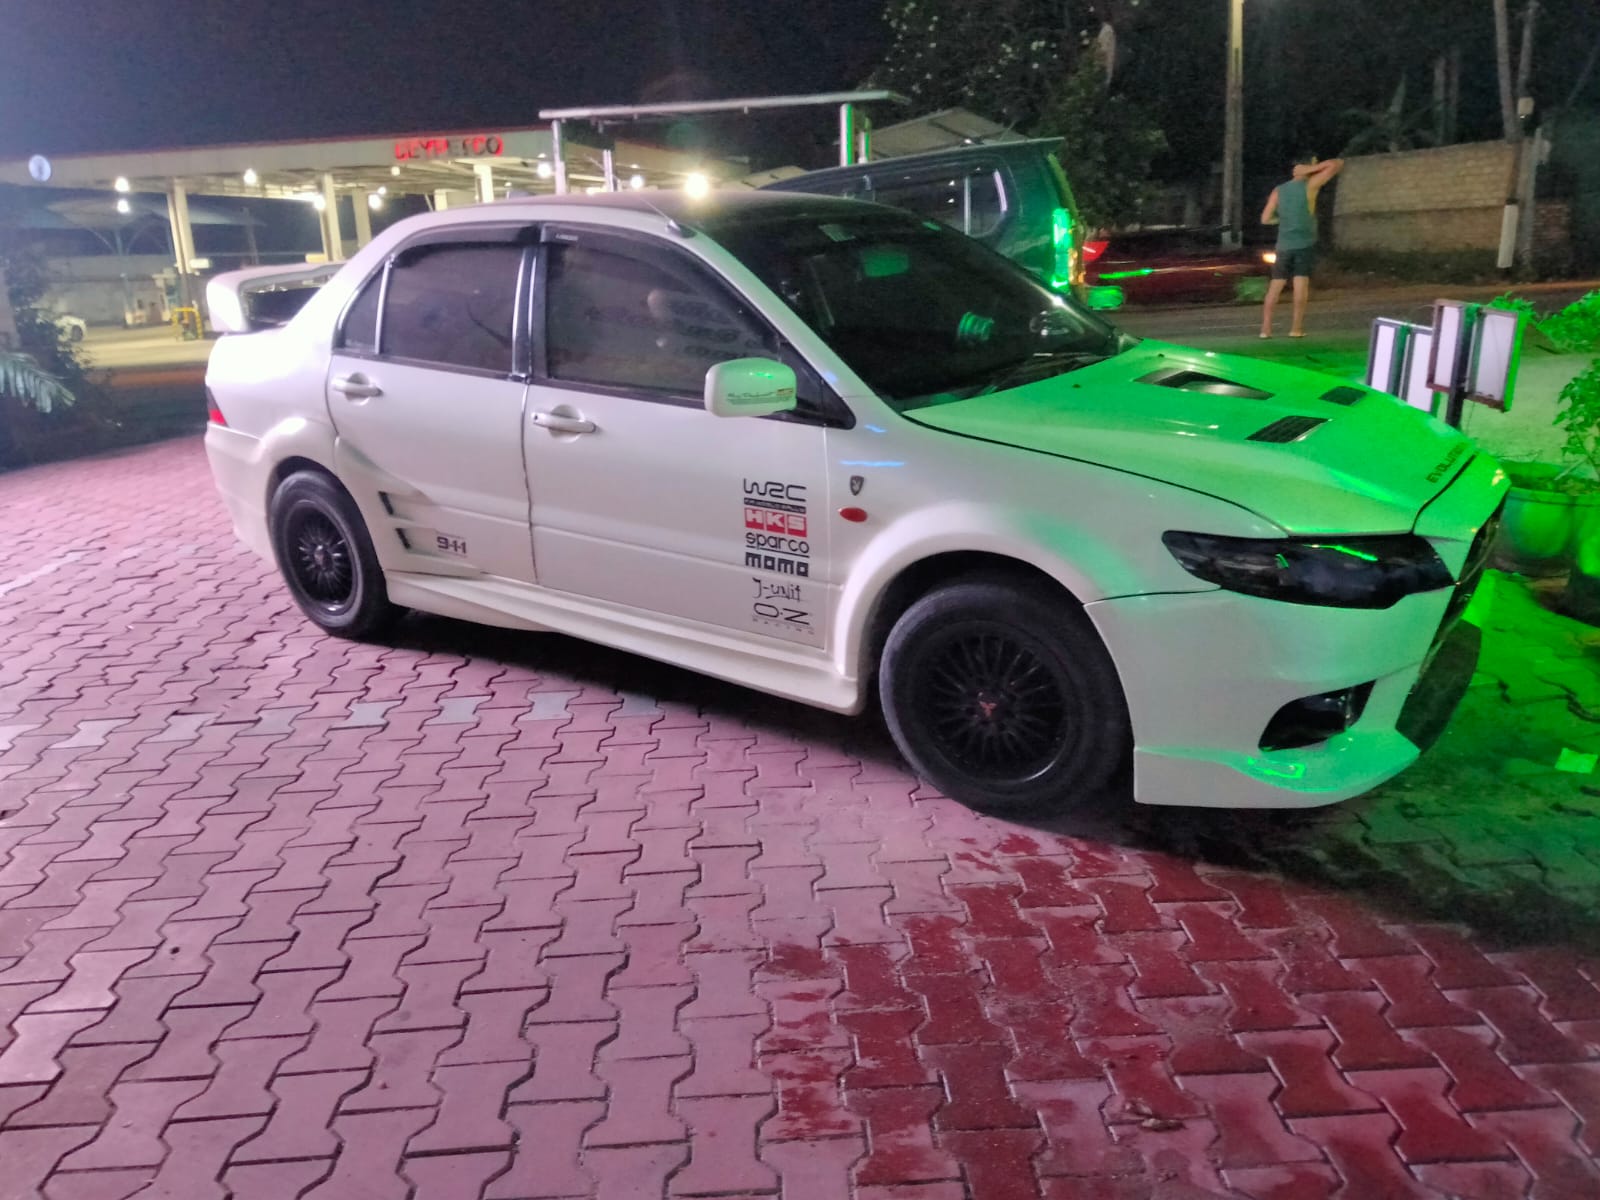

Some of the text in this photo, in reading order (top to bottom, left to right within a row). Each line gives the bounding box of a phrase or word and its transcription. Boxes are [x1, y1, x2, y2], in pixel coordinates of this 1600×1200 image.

[743, 478, 807, 502] WRC
[745, 508, 806, 533] HKS
[745, 532, 810, 554] sparco
